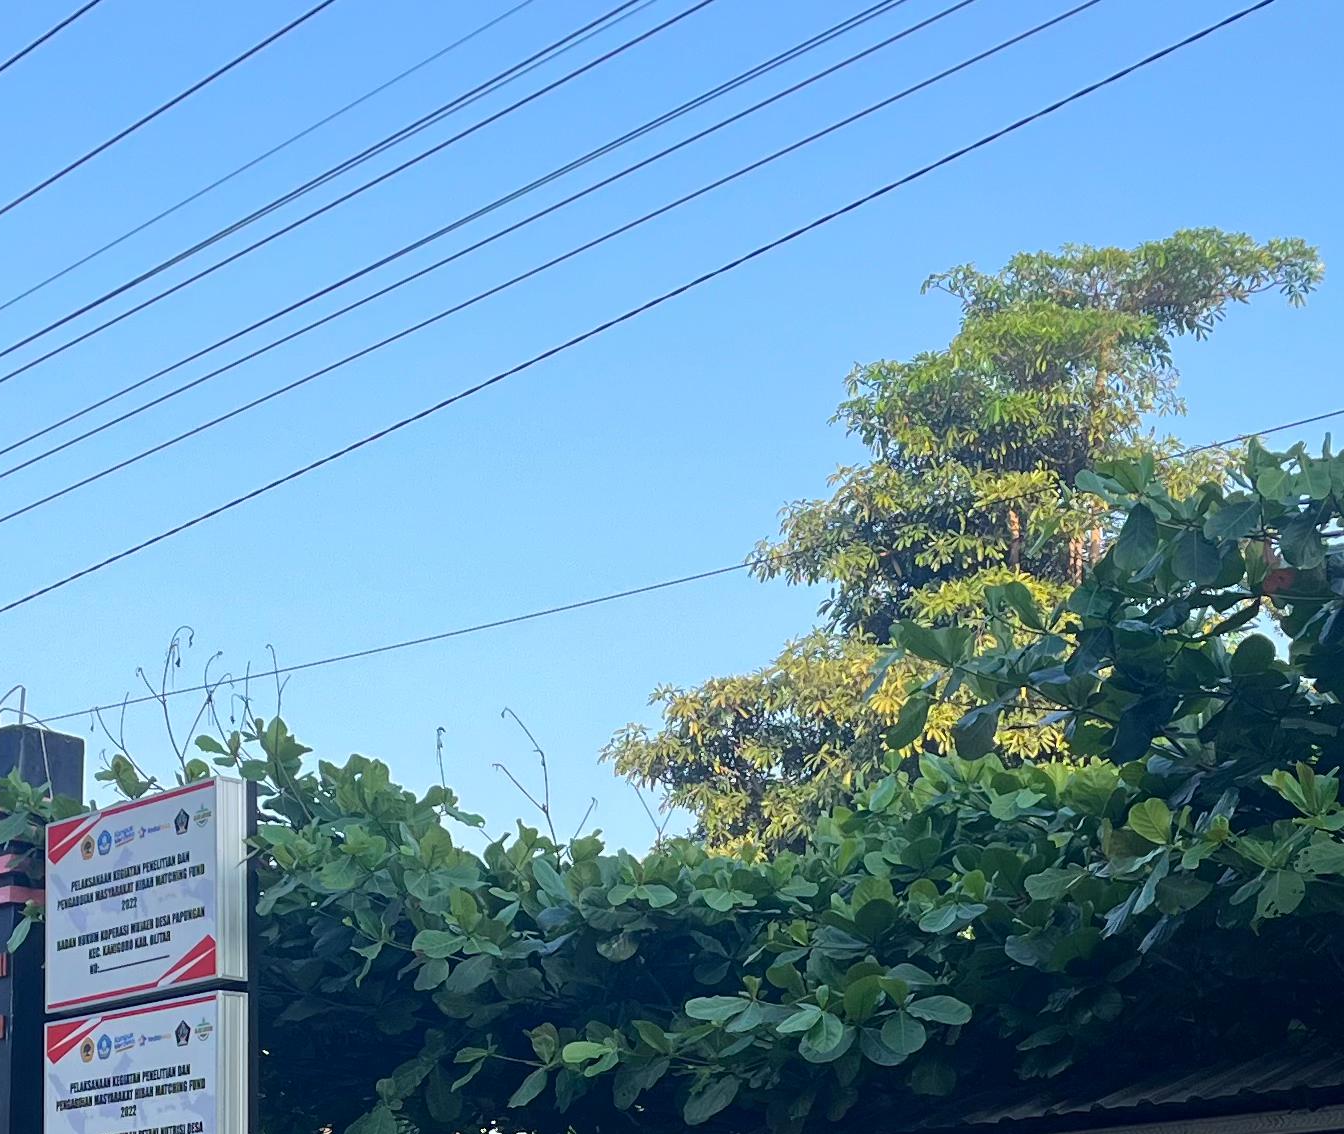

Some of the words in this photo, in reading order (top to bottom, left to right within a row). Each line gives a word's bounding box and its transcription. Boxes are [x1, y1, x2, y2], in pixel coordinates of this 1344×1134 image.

[122, 898, 137, 911] 2022
[121, 1105, 136, 1118] 2022
[187, 1121, 203, 1134] DESA
